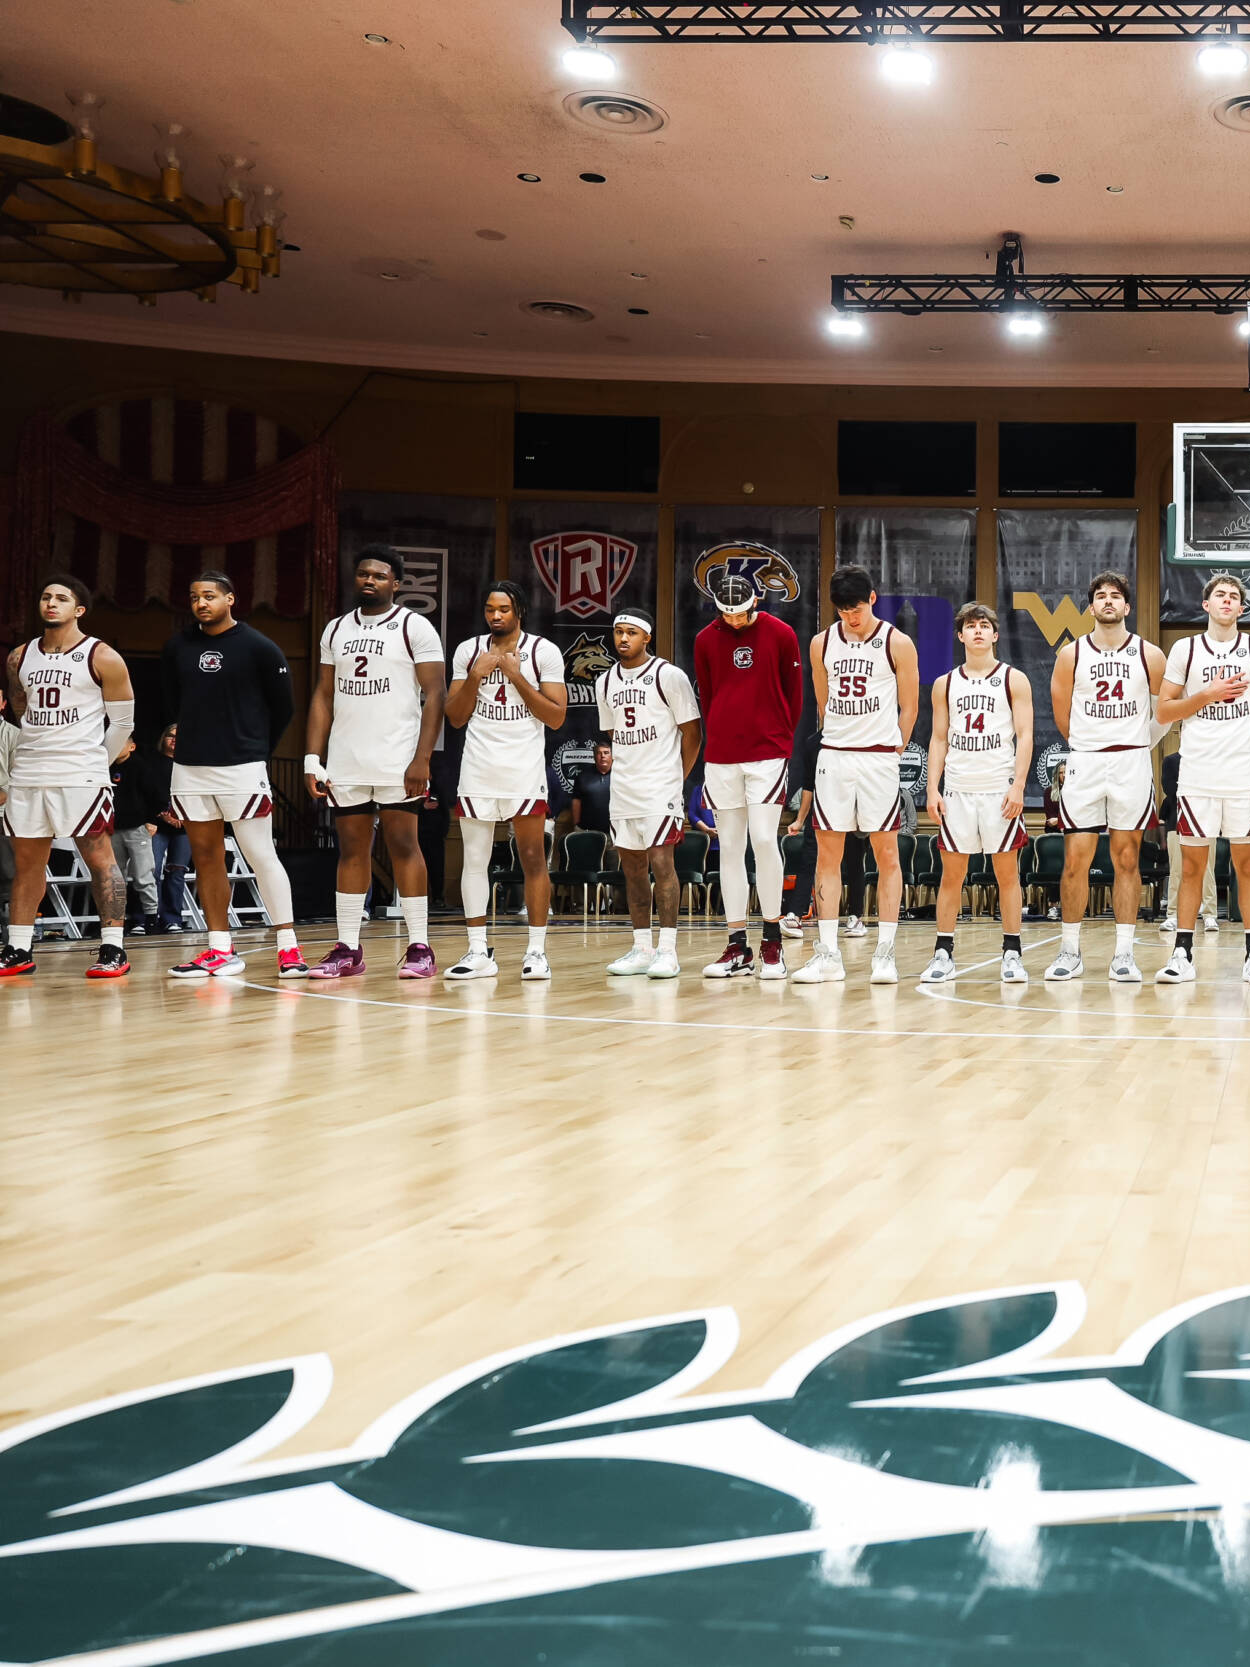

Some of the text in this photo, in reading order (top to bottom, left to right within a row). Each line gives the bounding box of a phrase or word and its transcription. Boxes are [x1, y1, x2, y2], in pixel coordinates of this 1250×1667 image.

[342, 639, 385, 656] SOUTH
[354, 656, 368, 677] 2
[833, 659, 874, 677] SOUTH
[1090, 662, 1130, 680] SOUTH
[27, 669, 73, 688] SOUTH
[338, 677, 390, 696] CAROLINA
[838, 676, 867, 697] 55
[37, 687, 61, 709] 10
[494, 684, 507, 706] 4
[612, 689, 646, 709] SOUTH
[1096, 680, 1124, 701] 24
[476, 699, 531, 721] CAROLINA
[829, 696, 880, 716] CAROLINA
[957, 695, 996, 714] SOUTH
[1084, 700, 1138, 719] CAROLINA
[624, 706, 636, 728] 5
[965, 713, 985, 733] 14
[612, 725, 657, 746] AROLINA
[951, 733, 1001, 752] CAROLINA
